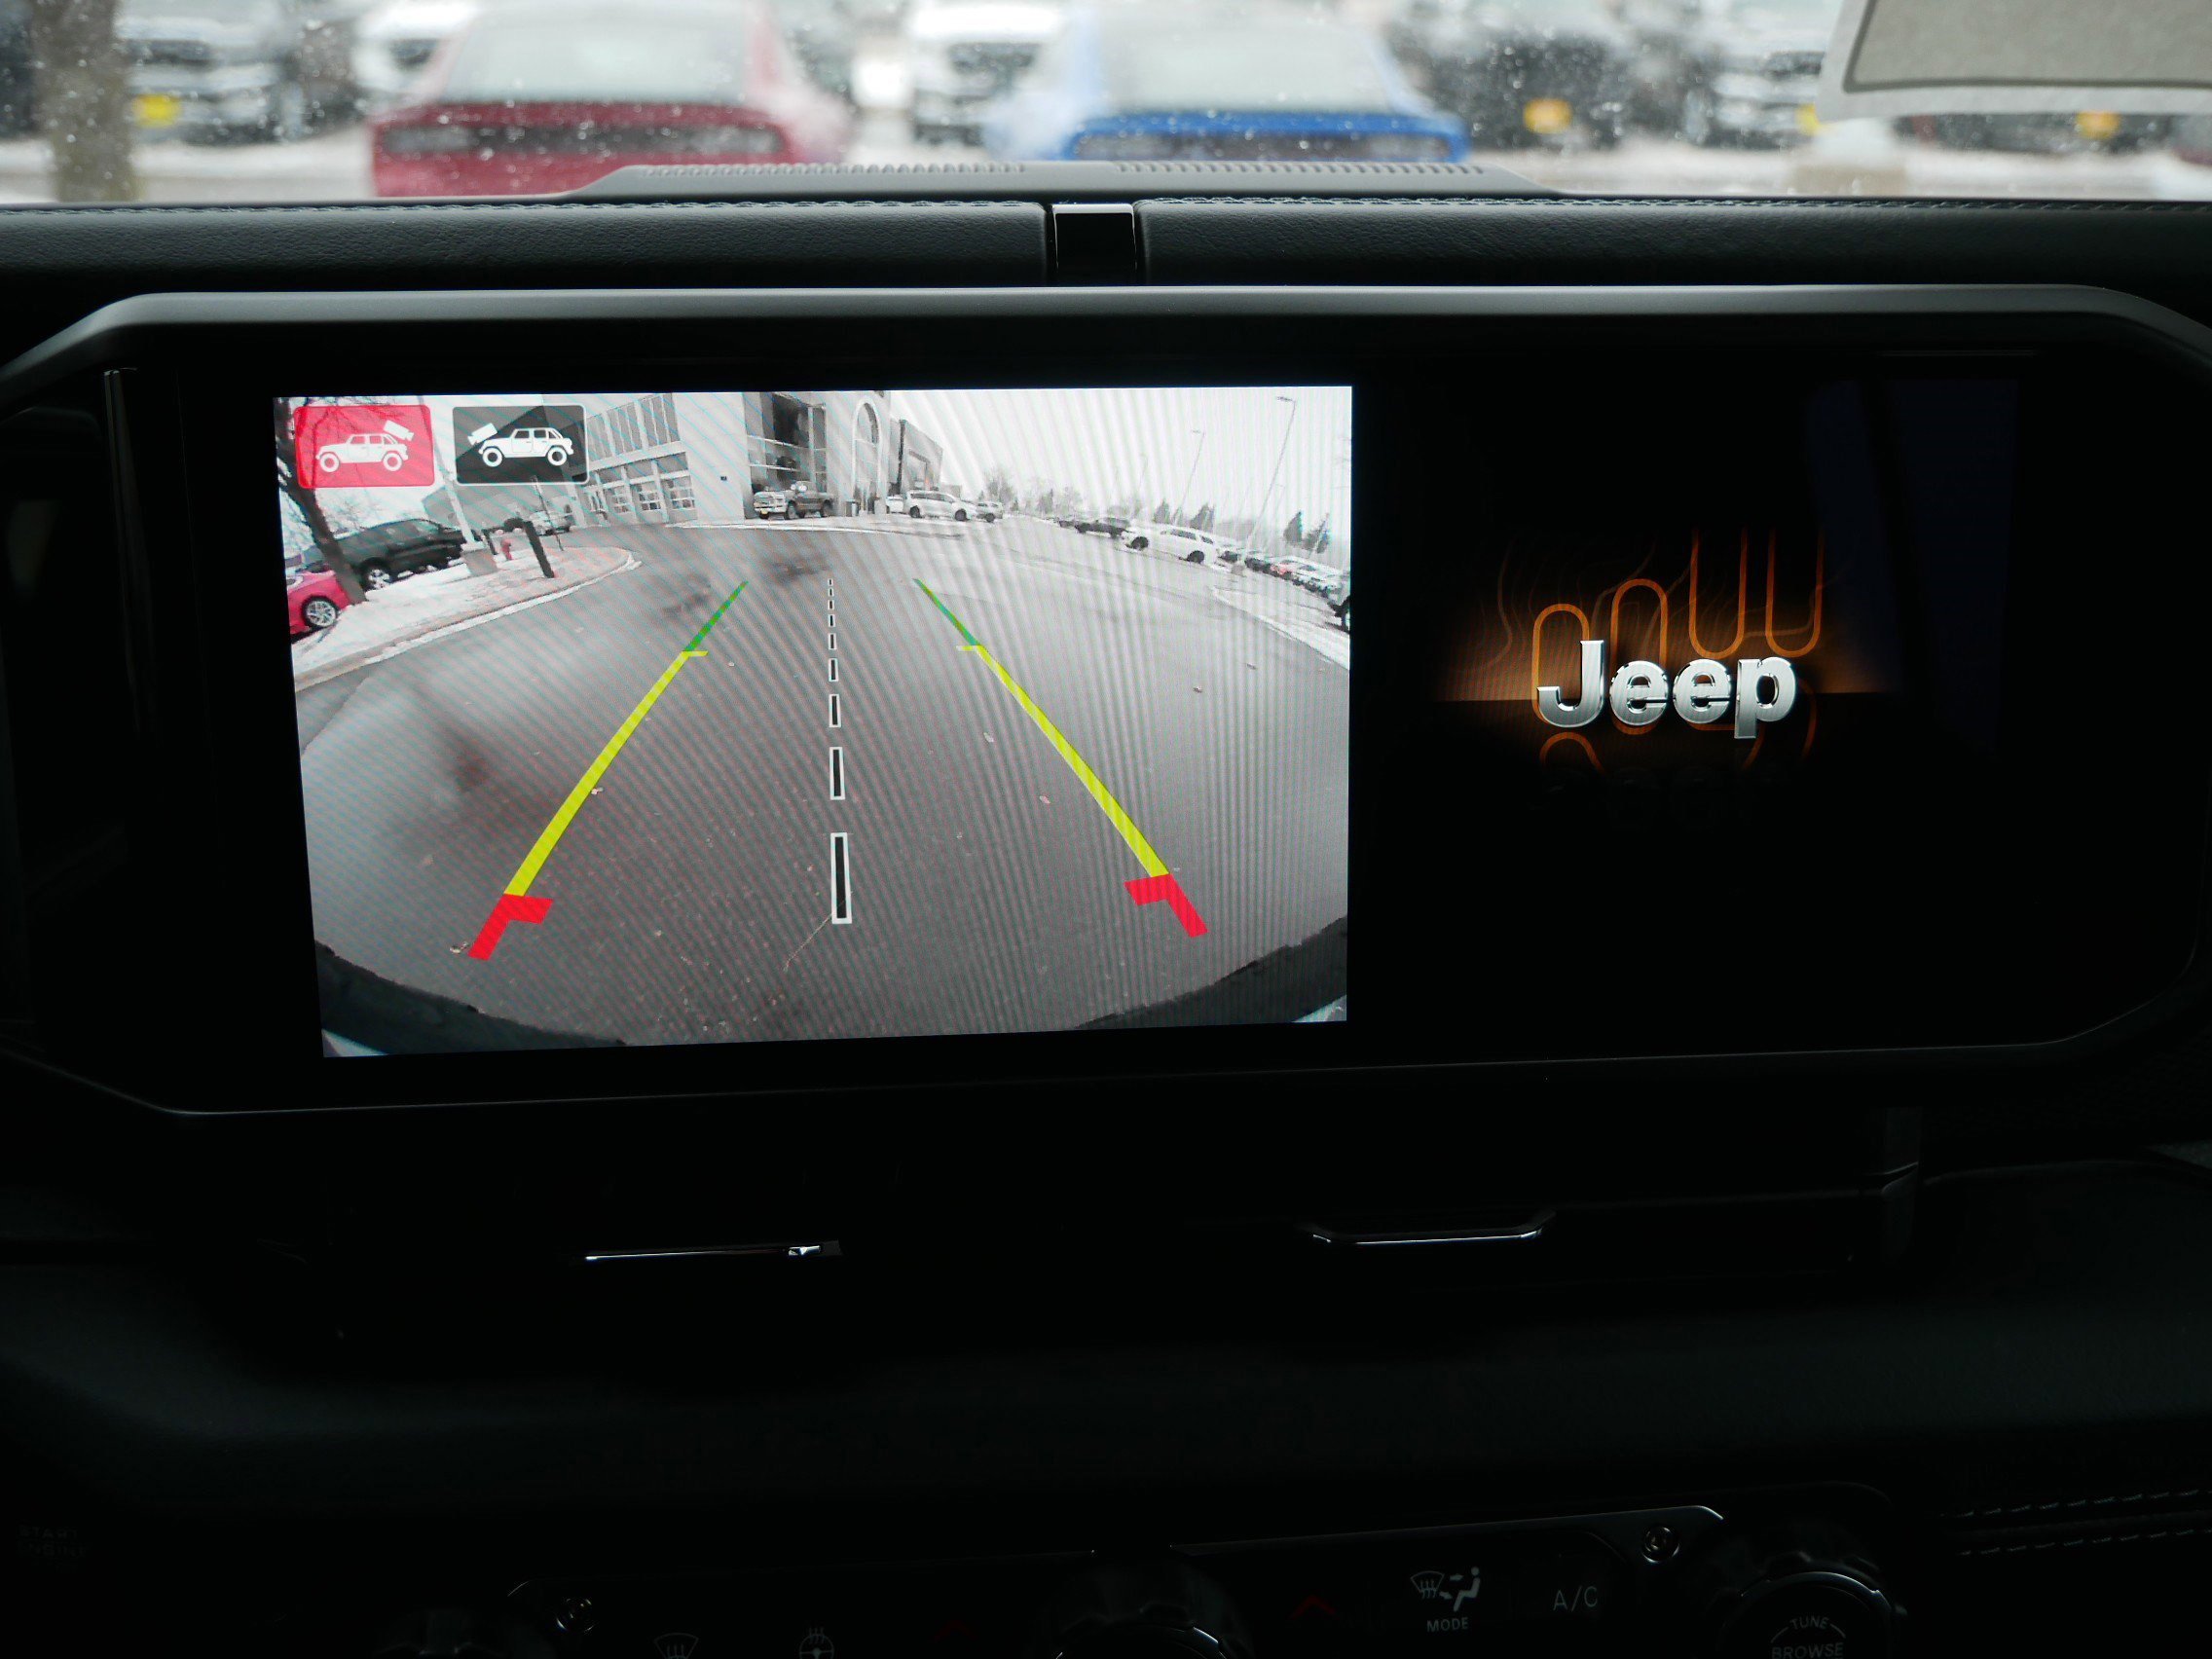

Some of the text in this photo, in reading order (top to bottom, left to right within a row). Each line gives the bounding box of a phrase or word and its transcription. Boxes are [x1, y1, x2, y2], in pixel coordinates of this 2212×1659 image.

[1536, 639, 1796, 740] Jeep
[1552, 1585, 1598, 1612] A/C
[1426, 1617, 1470, 1633] MODE
[1789, 1615, 1829, 1630] TUNE
[1771, 1641, 1844, 1659] BROWSE
